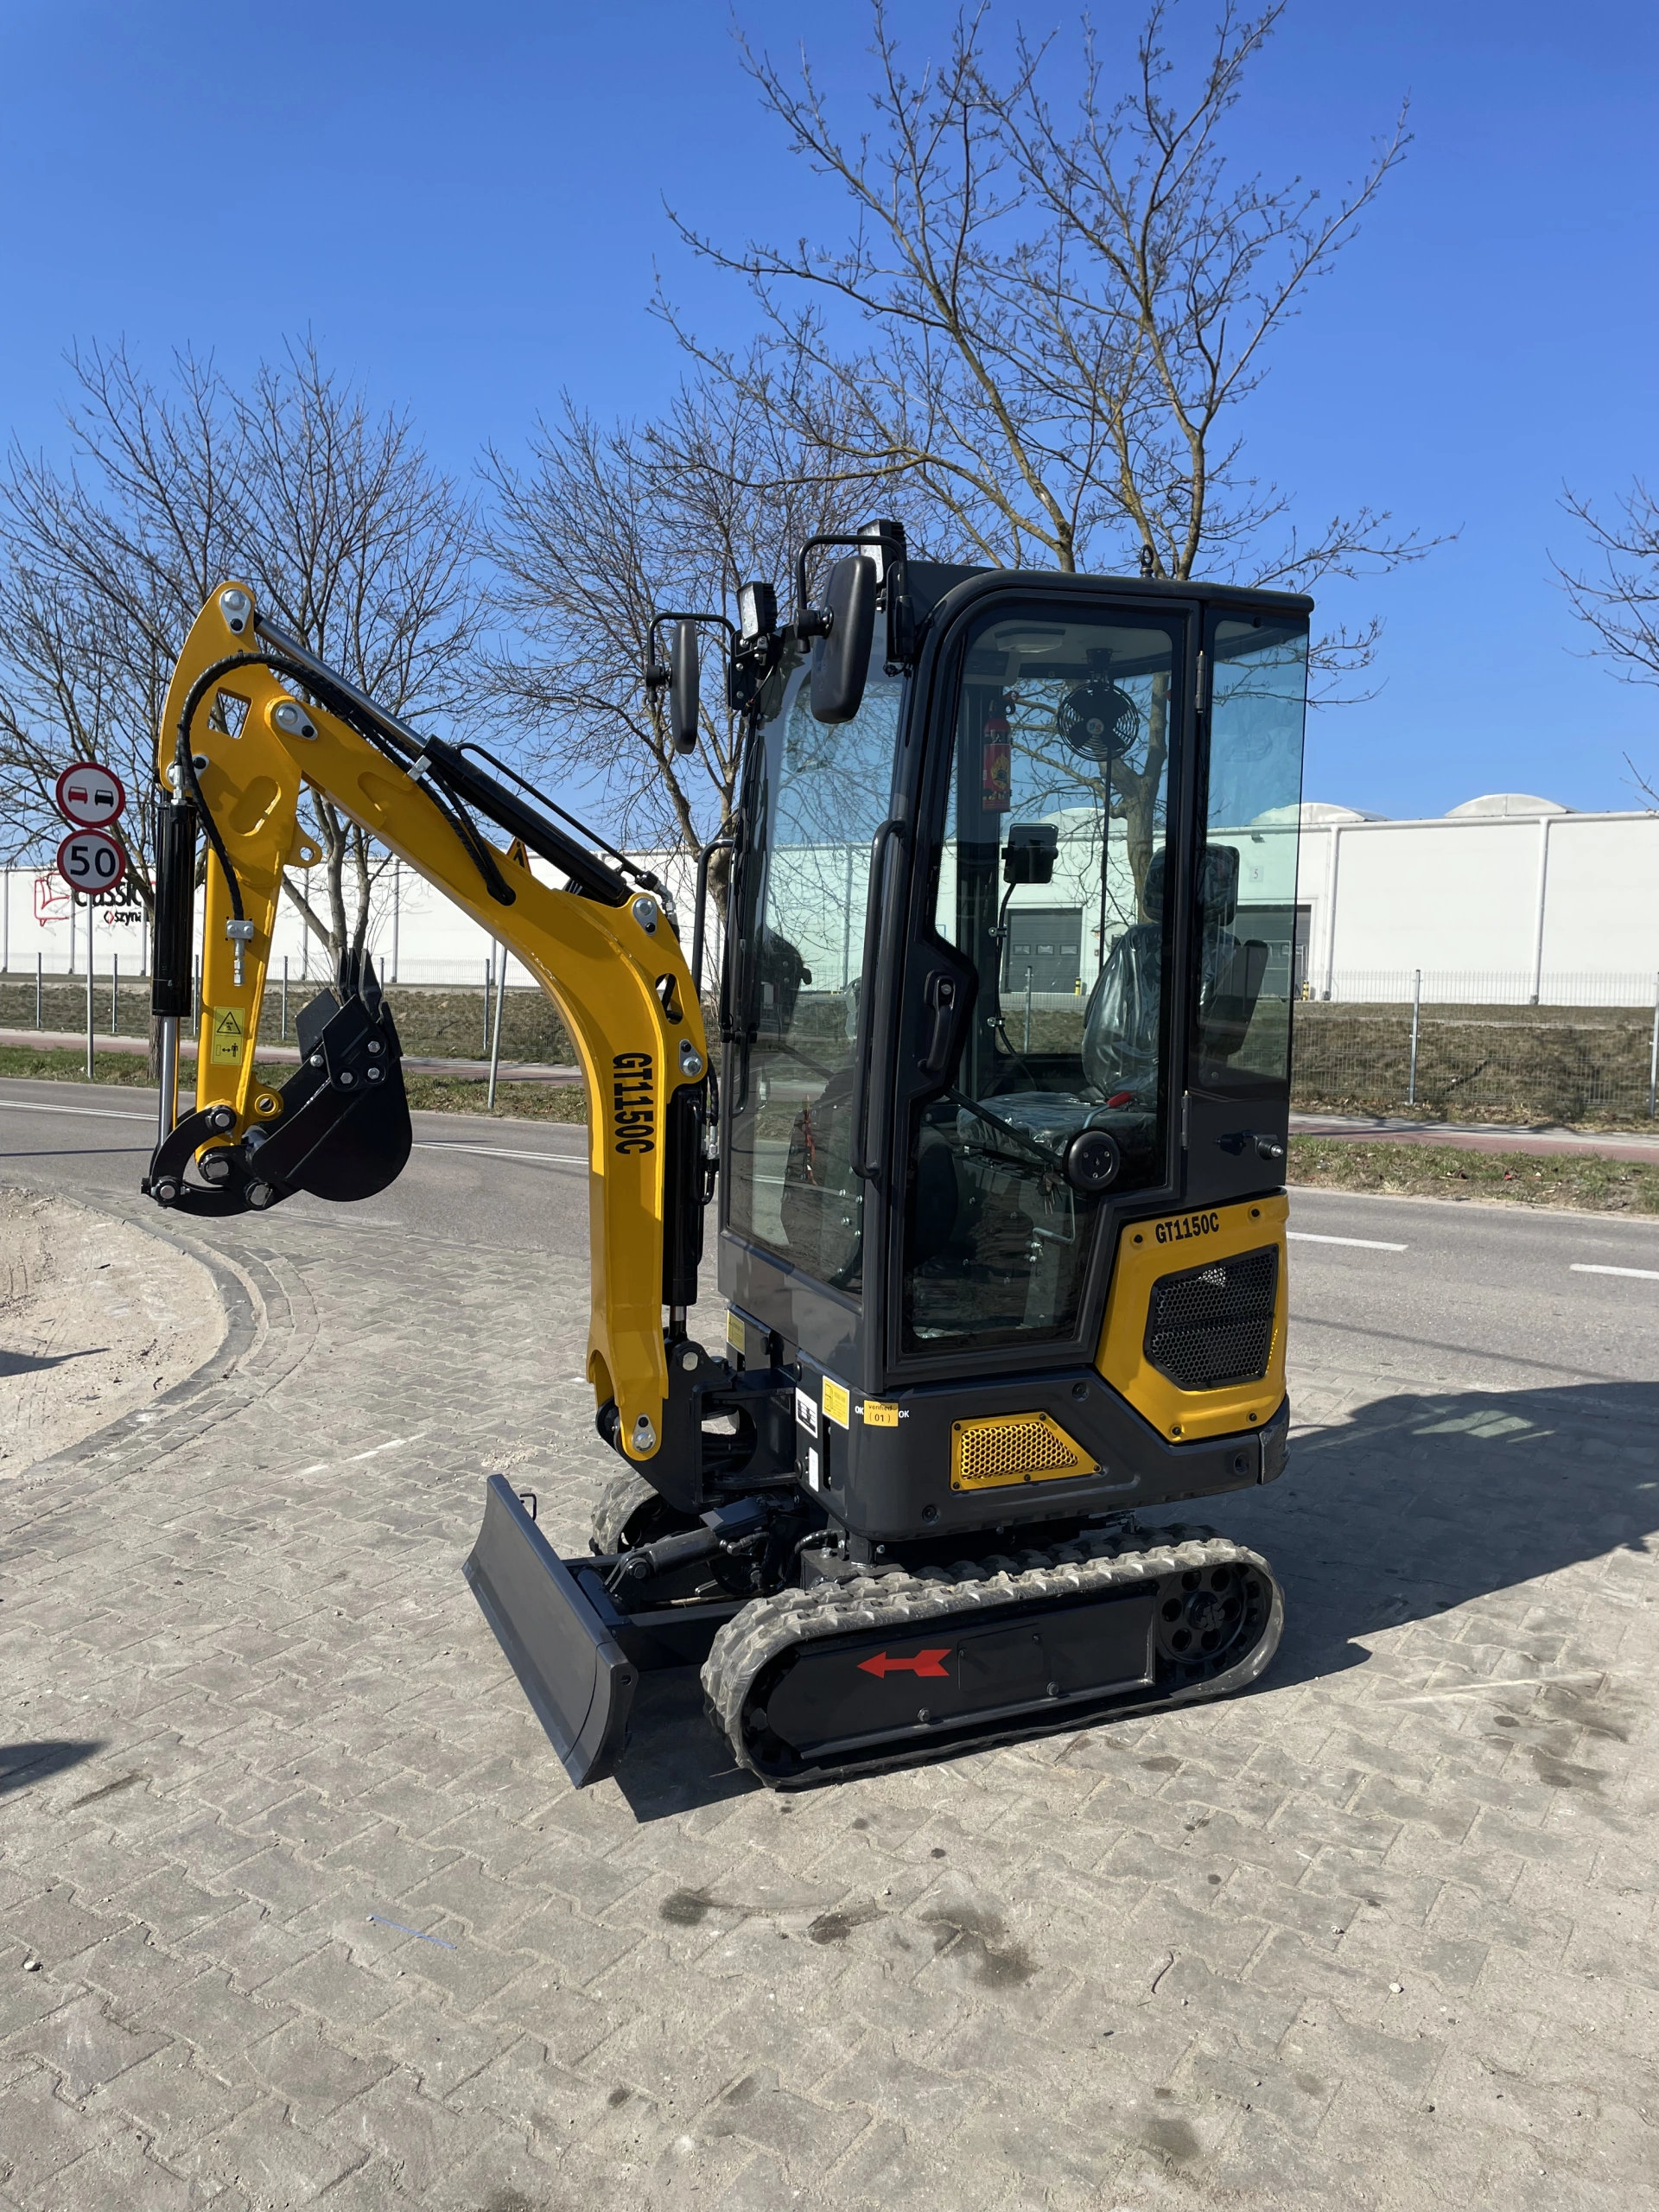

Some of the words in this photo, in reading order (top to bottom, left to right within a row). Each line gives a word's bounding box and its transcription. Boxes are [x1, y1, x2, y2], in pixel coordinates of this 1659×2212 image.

[70, 845, 116, 877] 50
[75, 881, 142, 907] cassic
[613, 1052, 655, 1154] GT1150C
[1155, 1212, 1219, 1243] GT1150C
